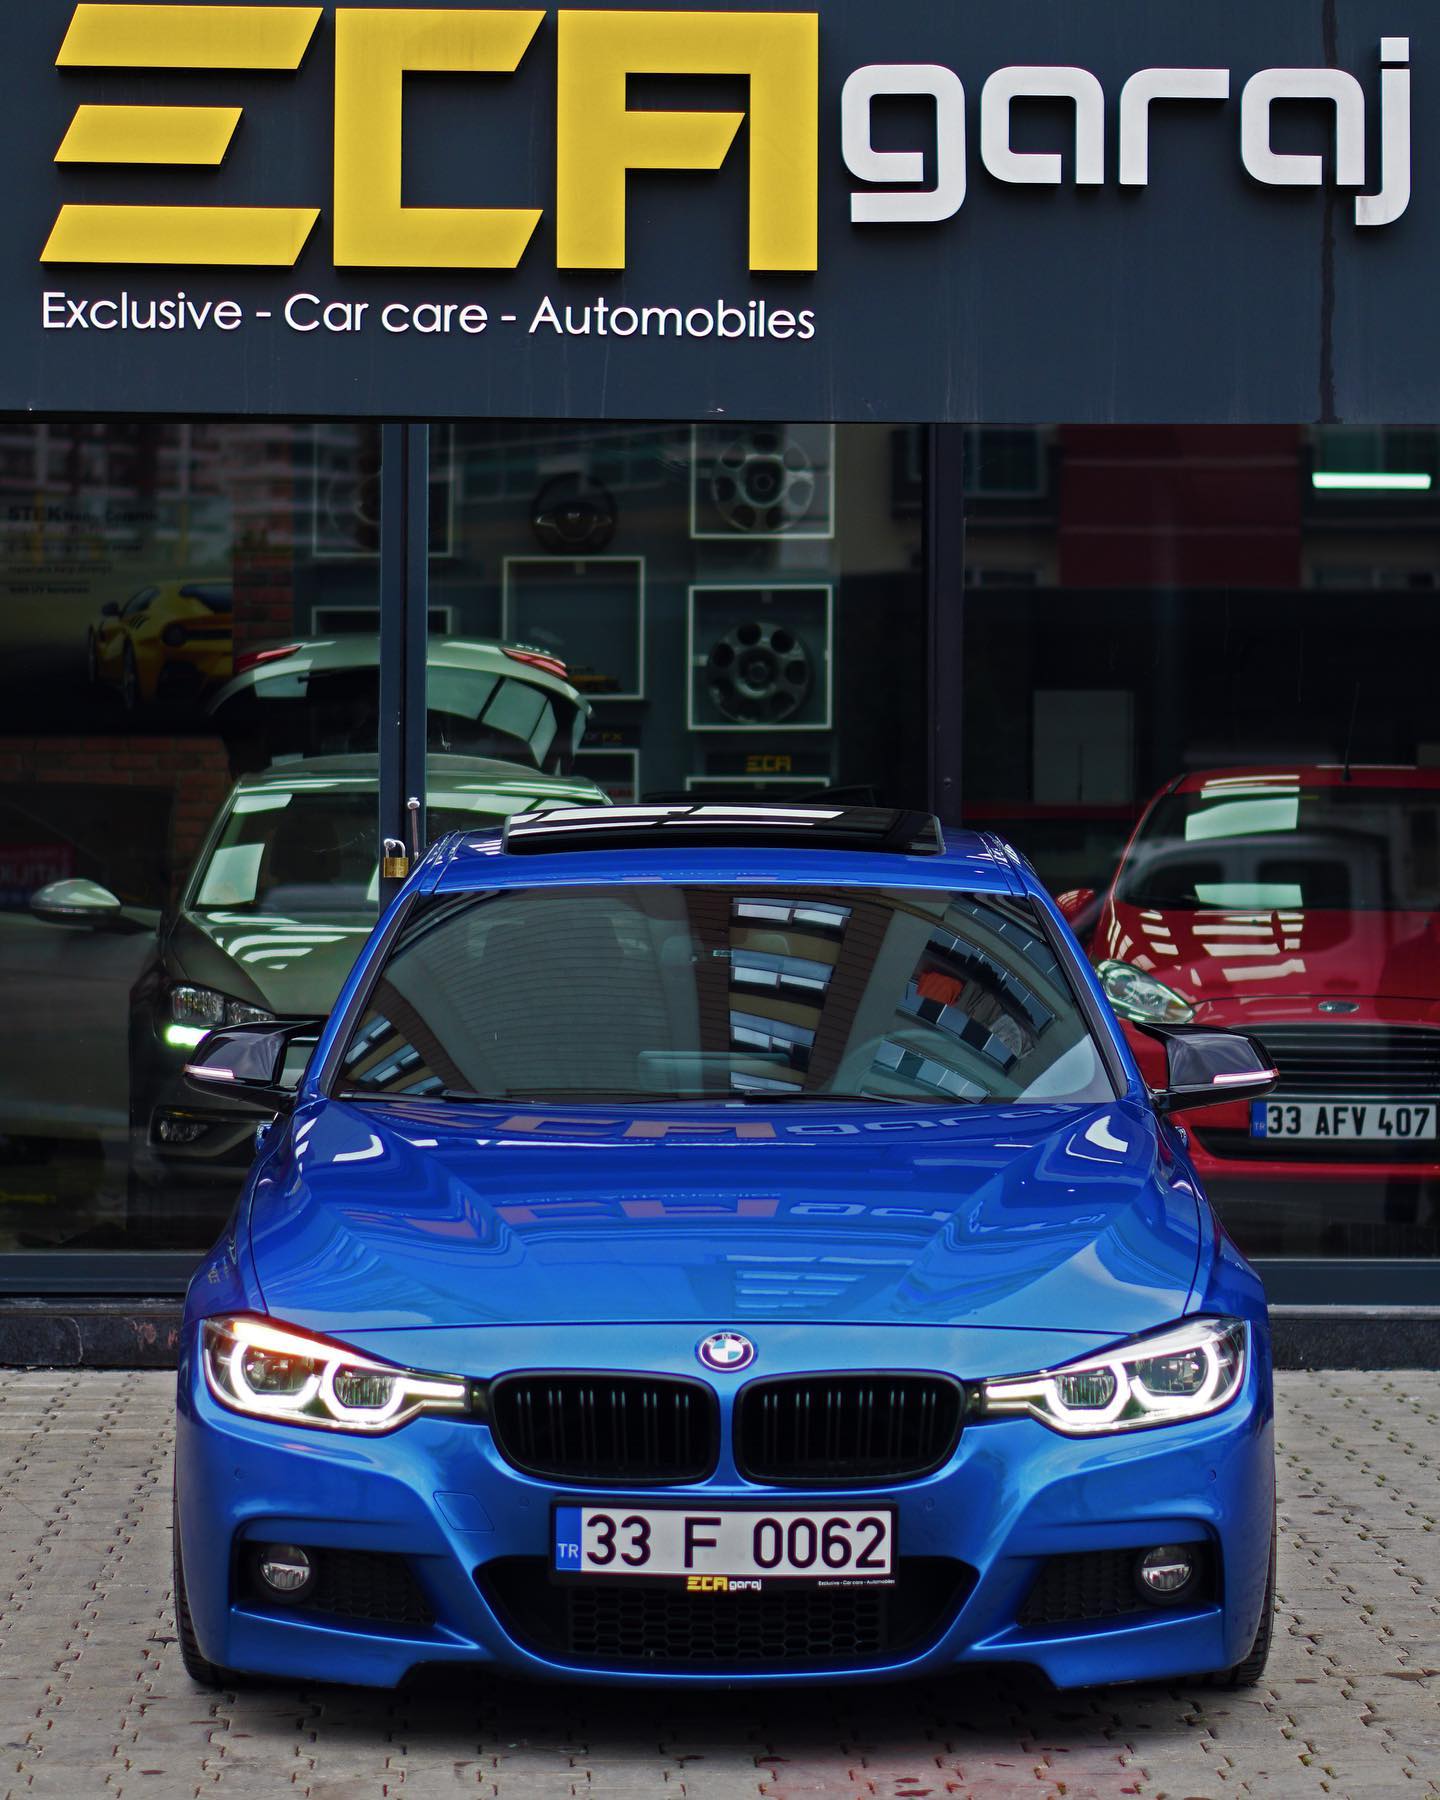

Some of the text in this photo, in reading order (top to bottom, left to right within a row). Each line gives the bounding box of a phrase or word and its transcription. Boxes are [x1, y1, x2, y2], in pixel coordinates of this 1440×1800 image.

[39, 3, 1411, 272] ECA garaj
[43, 292, 242, 329] Exclusive
[285, 294, 368, 331] Car
[382, 304, 487, 333] care
[529, 296, 814, 338] Automobiles
[1267, 1105, 1301, 1135] 33
[1315, 1106, 1367, 1136] AFV
[1377, 1107, 1431, 1137] 407
[557, 1513, 887, 1569] TR 33 F 0062
[687, 1576, 762, 1591] ECA garaj
